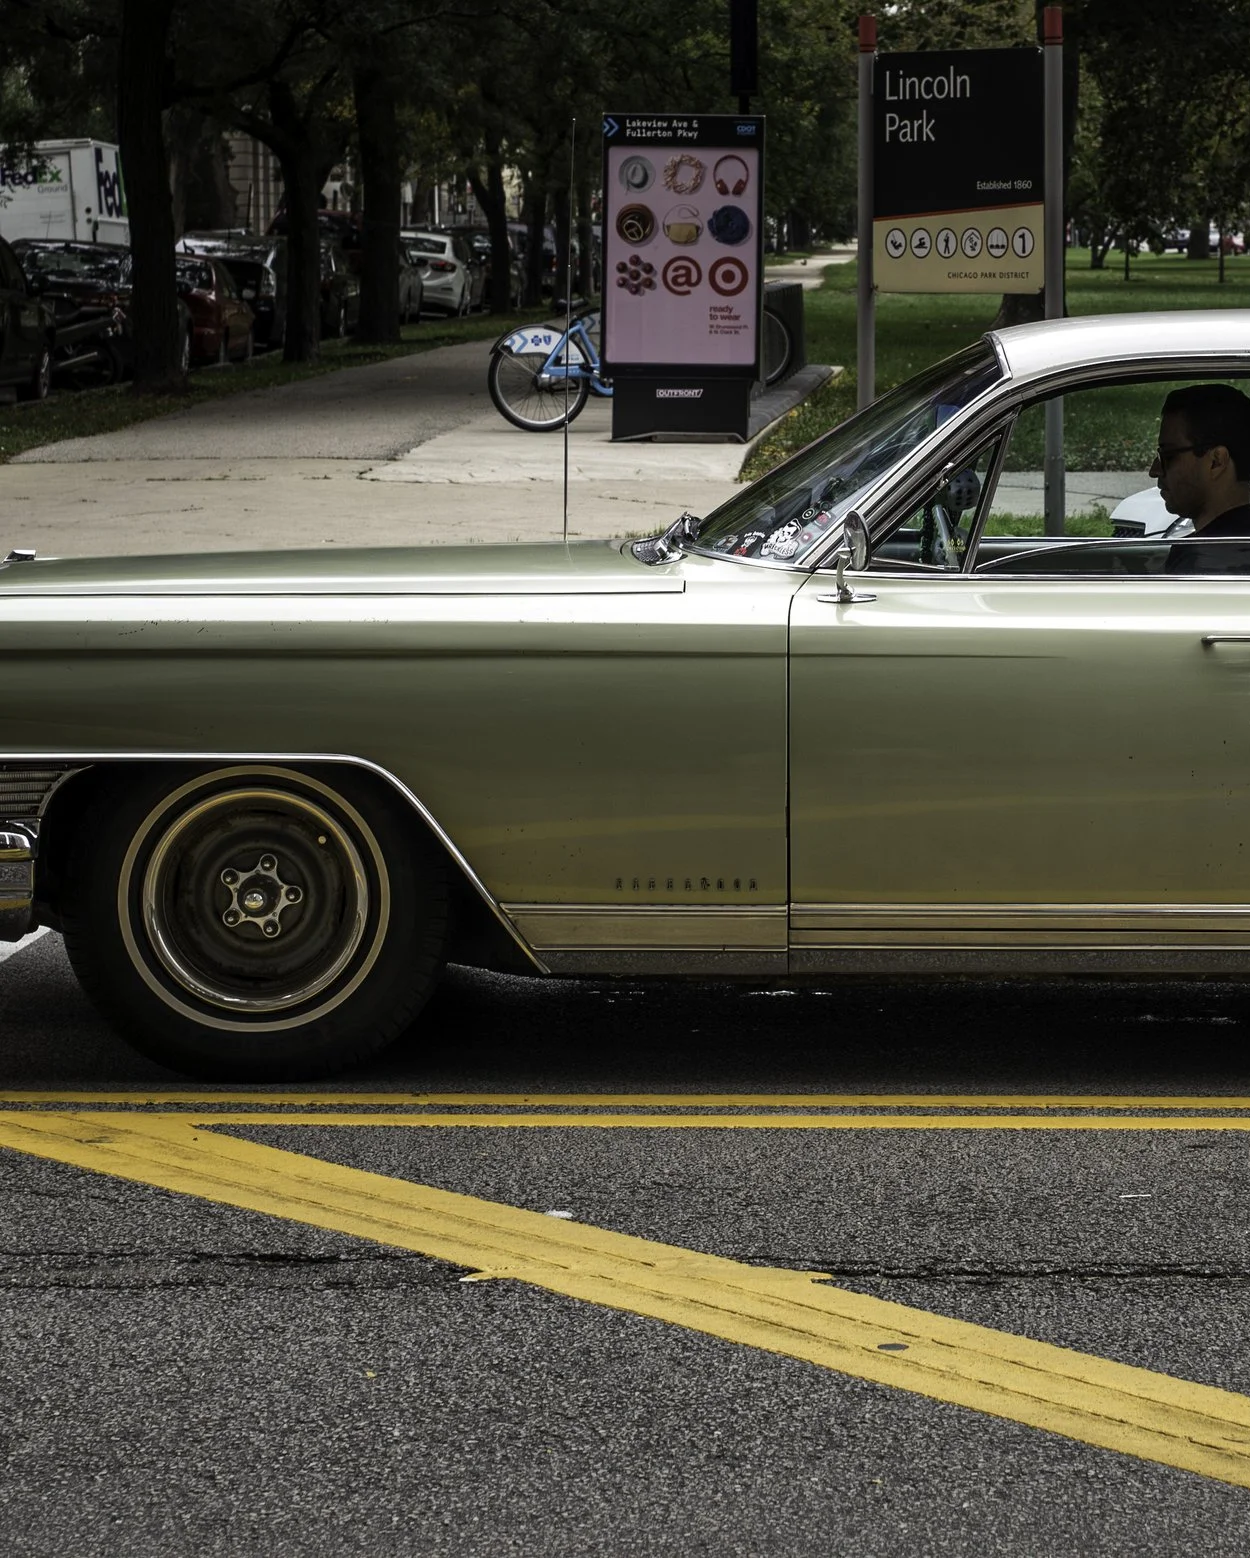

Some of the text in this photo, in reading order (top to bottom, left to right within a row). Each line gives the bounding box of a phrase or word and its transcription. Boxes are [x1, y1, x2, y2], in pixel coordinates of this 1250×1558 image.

[885, 65, 971, 101] Lincoln
[626, 119, 699, 128] Lakeview Ave &
[885, 109, 936, 143] Park
[626, 128, 699, 139] Fullerton Pkwy
[37, 184, 69, 194] Ground
[976, 179, 1033, 190] Established 1860
[947, 271, 1030, 279] CHICAGO PARK DISTRICT
[709, 305, 734, 314] ready
[709, 313, 718, 321] to
[657, 389, 702, 398] OUTFRONT
